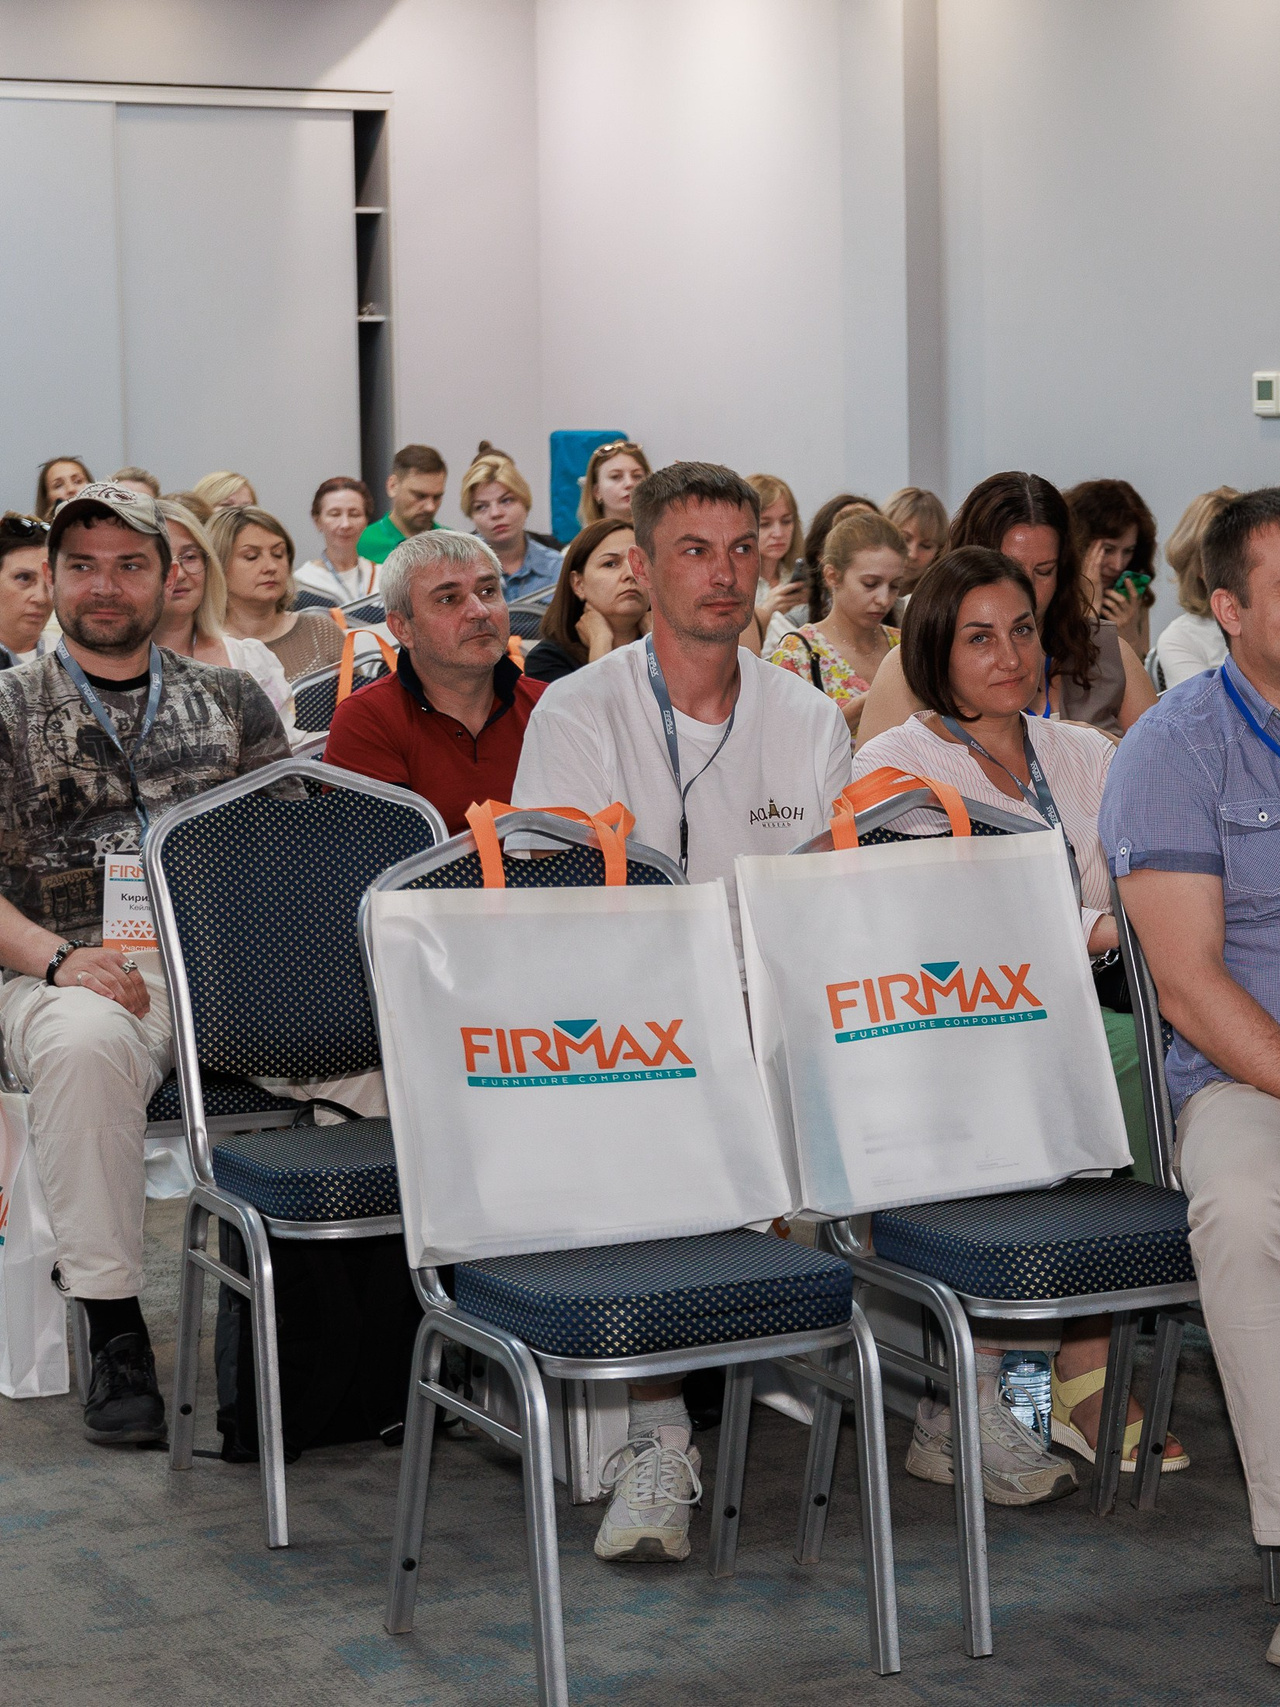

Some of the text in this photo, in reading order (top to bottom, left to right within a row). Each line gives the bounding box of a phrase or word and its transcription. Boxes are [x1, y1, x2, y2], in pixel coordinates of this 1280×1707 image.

[121, 893, 151, 903] Кири
[826, 961, 1043, 1029] FIRMAX
[849, 1012, 1035, 1040] FURNITURE COMPONENTS
[460, 1019, 693, 1074] FIRMAX
[481, 1069, 683, 1086] FURNITURE COMPONENTS
